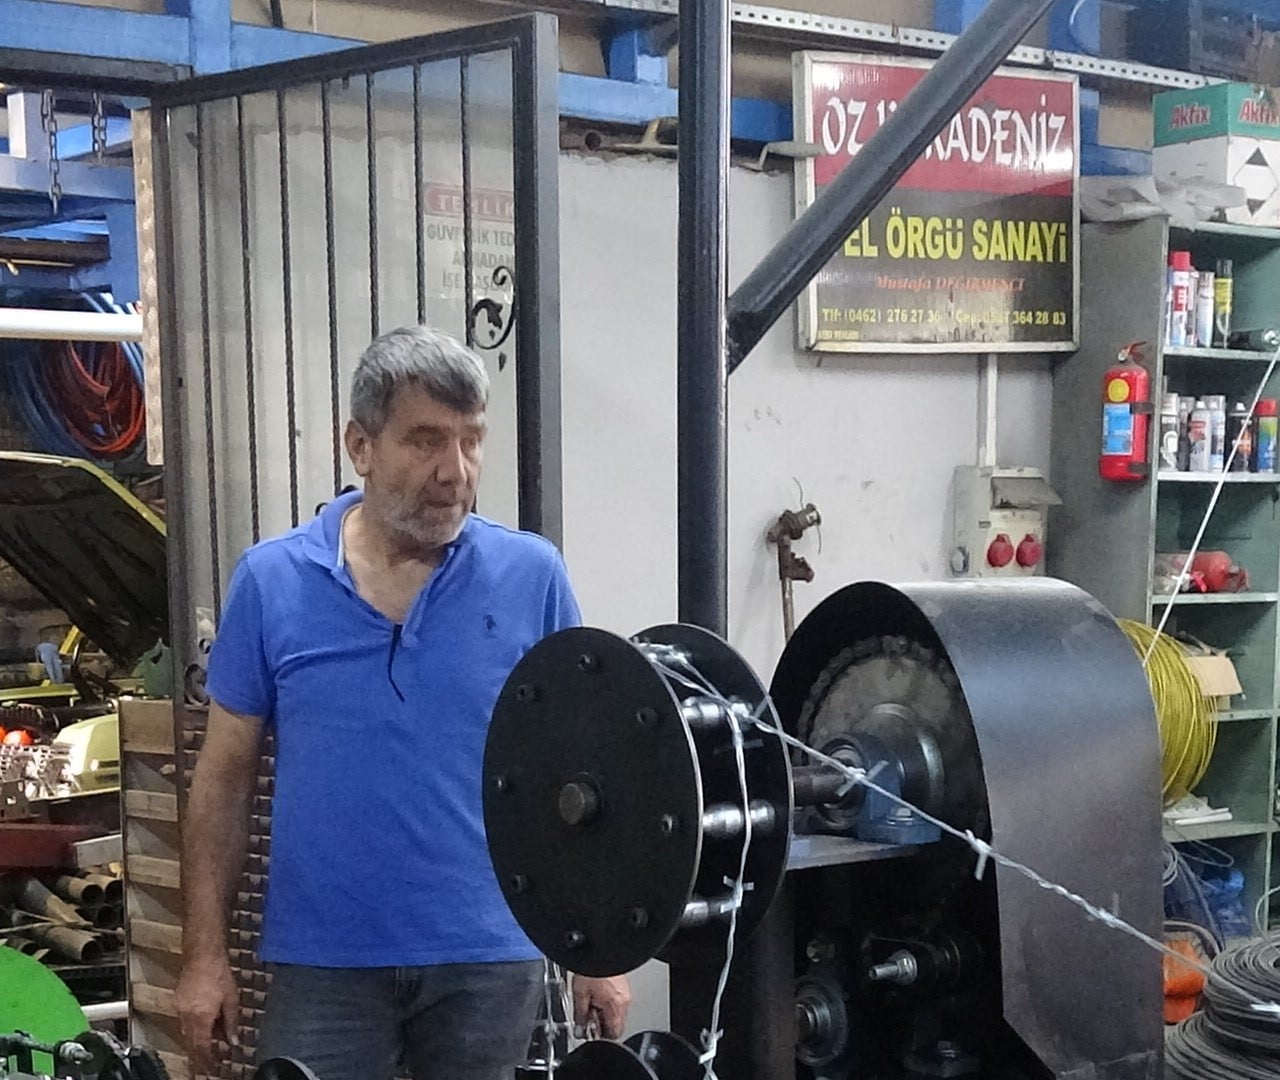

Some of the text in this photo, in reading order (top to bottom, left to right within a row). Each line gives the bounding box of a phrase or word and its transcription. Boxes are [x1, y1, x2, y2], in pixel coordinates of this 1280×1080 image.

[835, 217, 878, 257] EL
[886, 206, 963, 260] ÖRGÜ
[887, 308, 908, 323] 276
[910, 309, 924, 323] 27
